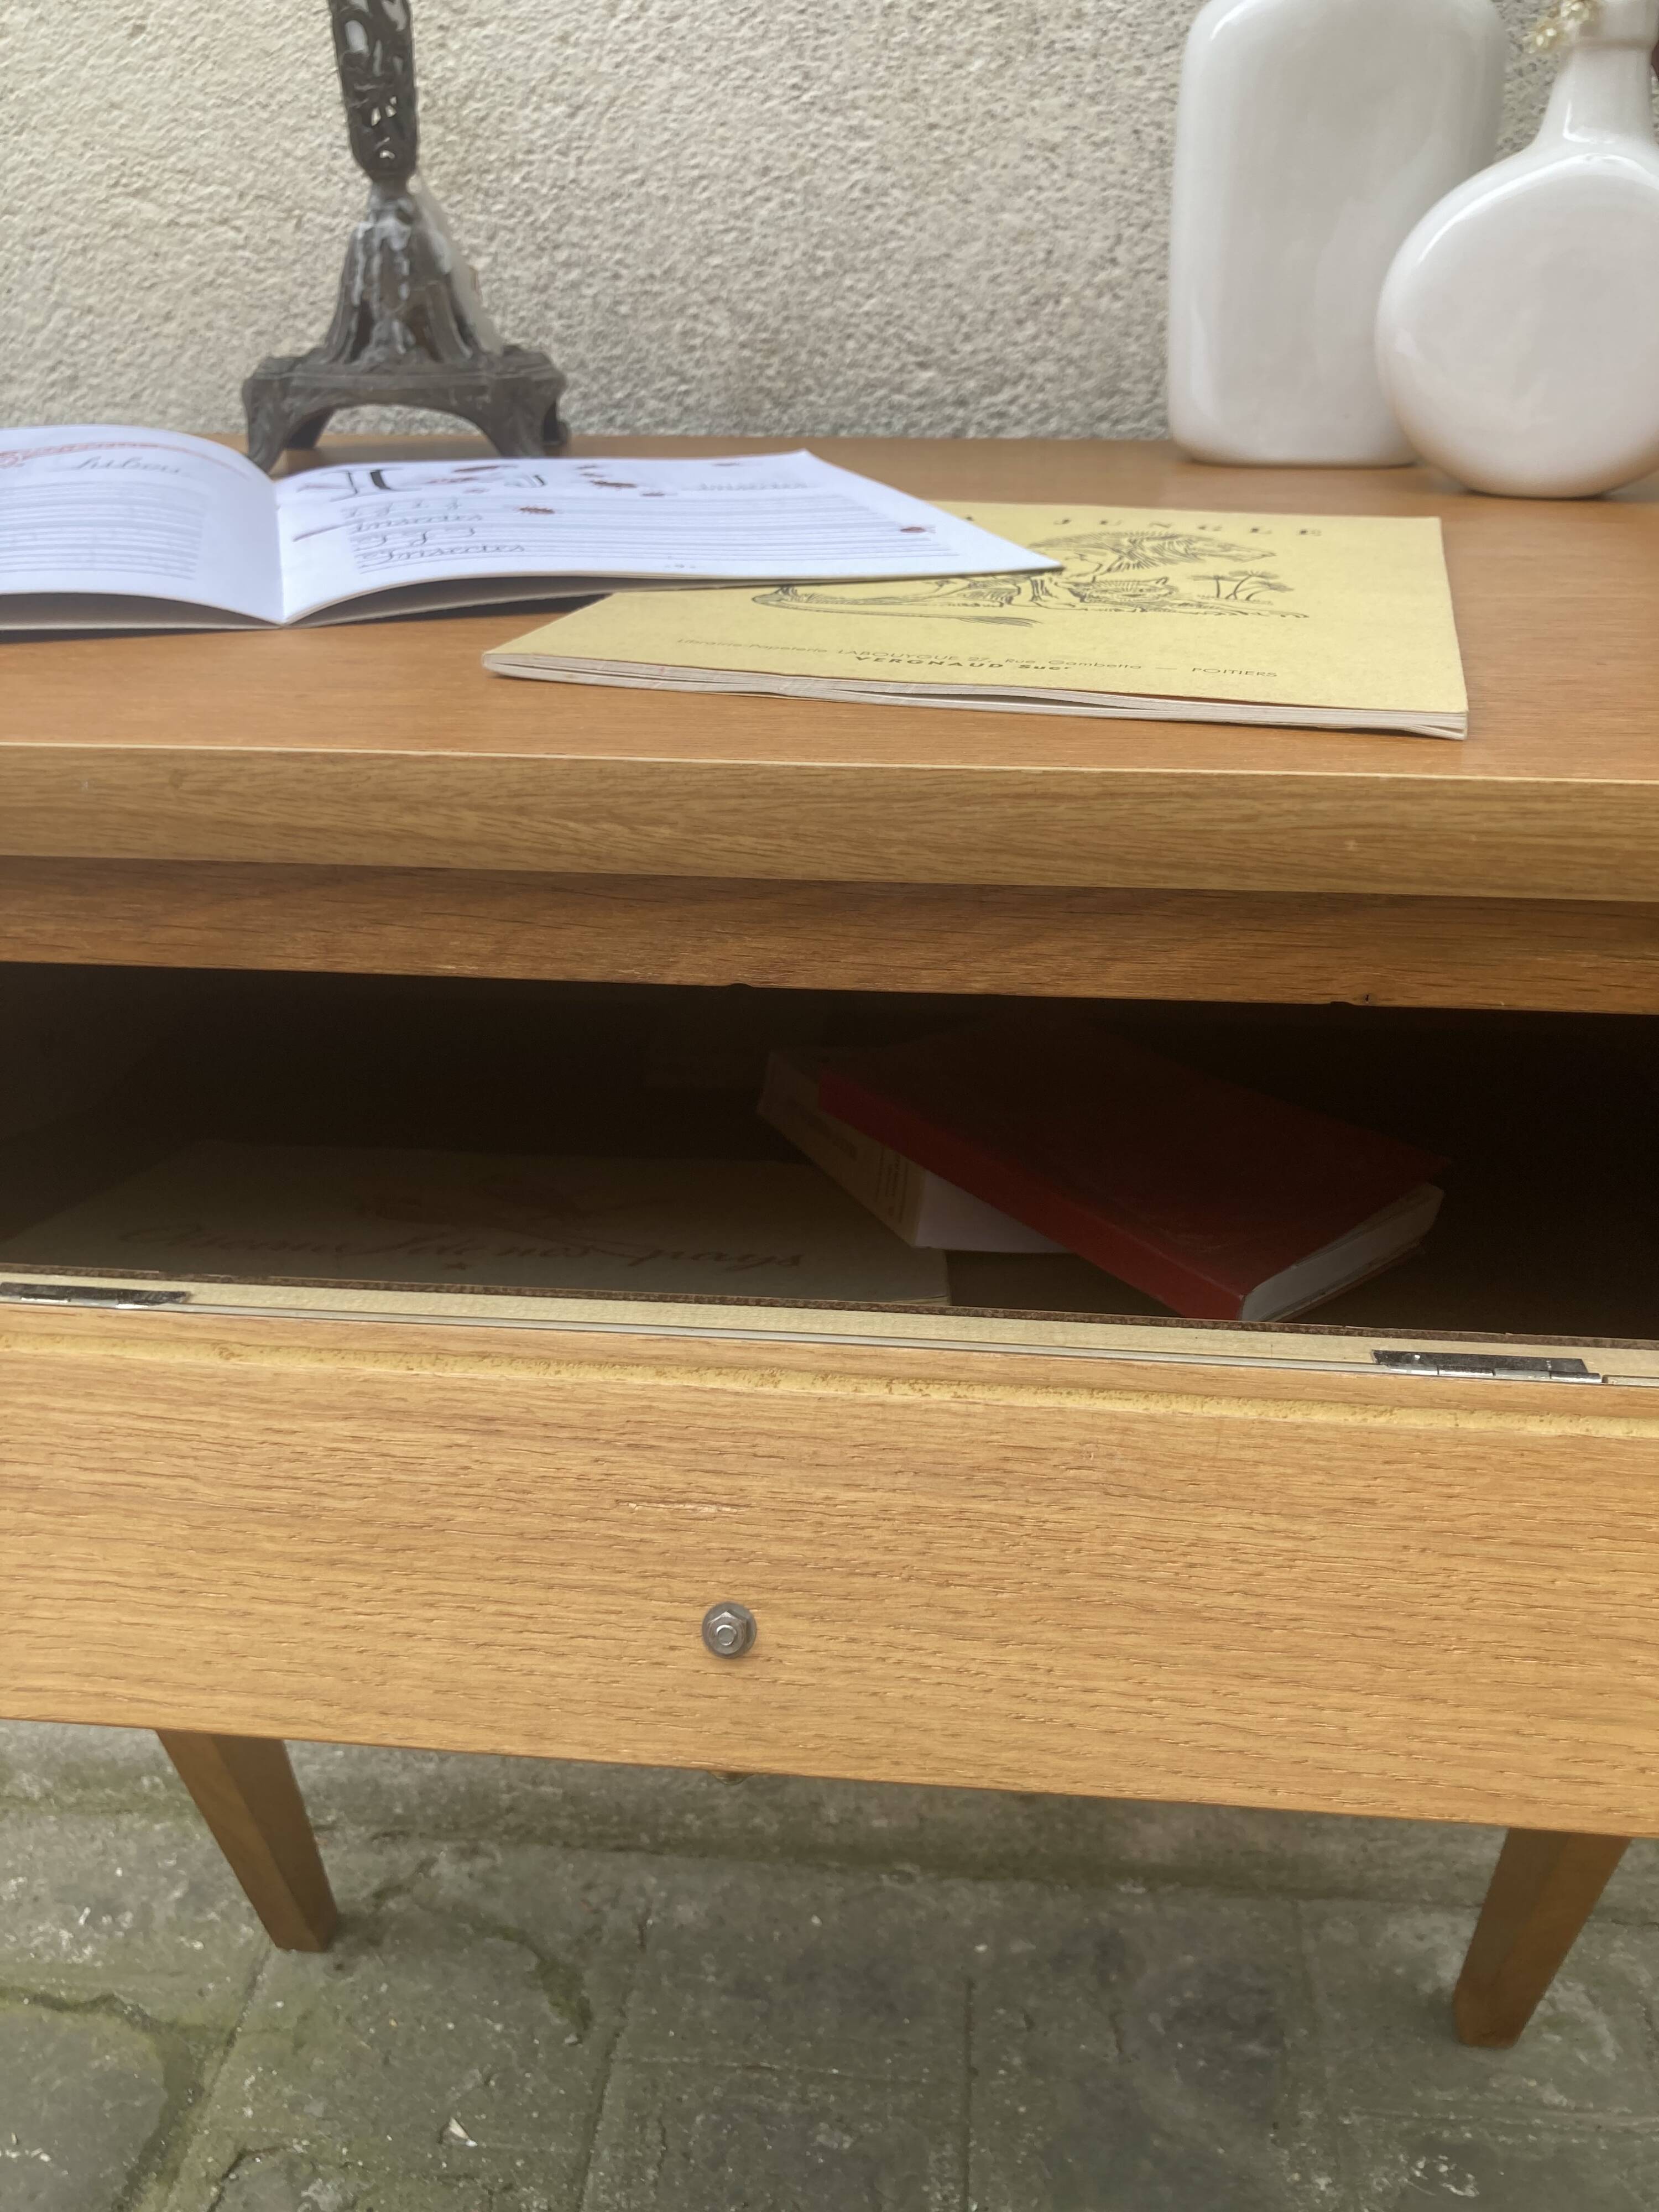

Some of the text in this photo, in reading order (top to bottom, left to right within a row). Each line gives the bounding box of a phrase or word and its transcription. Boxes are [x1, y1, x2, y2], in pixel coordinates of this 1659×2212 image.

[855, 656, 1004, 669] VERGNAUD
[1048, 660, 1142, 670] Gambetta
[1192, 667, 1279, 677] POITIERS
